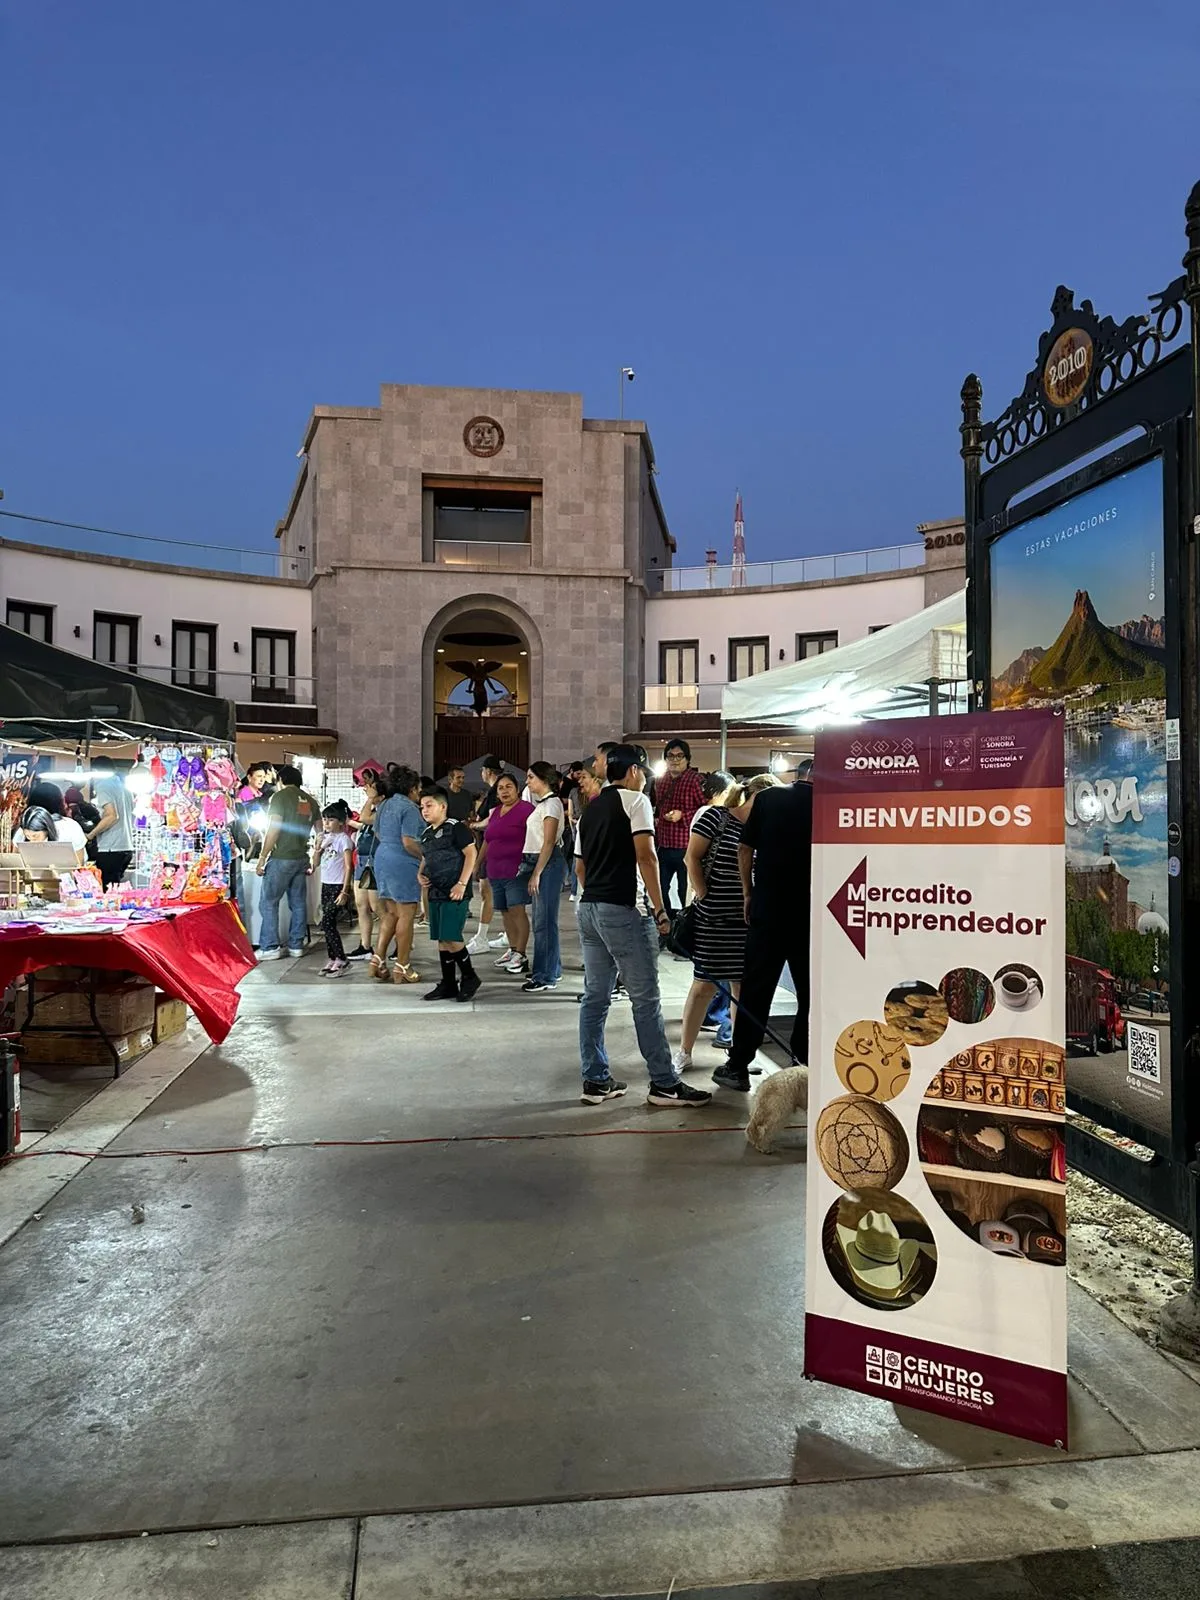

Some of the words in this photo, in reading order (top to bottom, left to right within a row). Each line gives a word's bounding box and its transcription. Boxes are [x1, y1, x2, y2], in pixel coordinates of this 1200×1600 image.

[1048, 346, 1087, 386] 2010
[924, 532, 965, 550] 2010
[1025, 537, 1051, 556] ESTAS
[1054, 507, 1118, 542] VACACIONES
[844, 754, 920, 770] SONORA
[980, 754, 1017, 763] ECONOMÍA
[838, 805, 1032, 828] BIENVENIDOS
[847, 883, 973, 905] Mercadito
[847, 905, 1047, 936] Emprendedor
[903, 1355, 984, 1387] CENTRO
[903, 1370, 995, 1405] MUJERES
[904, 1385, 957, 1404] TRANSFORMANDO
[957, 1399, 983, 1411] SONORA
